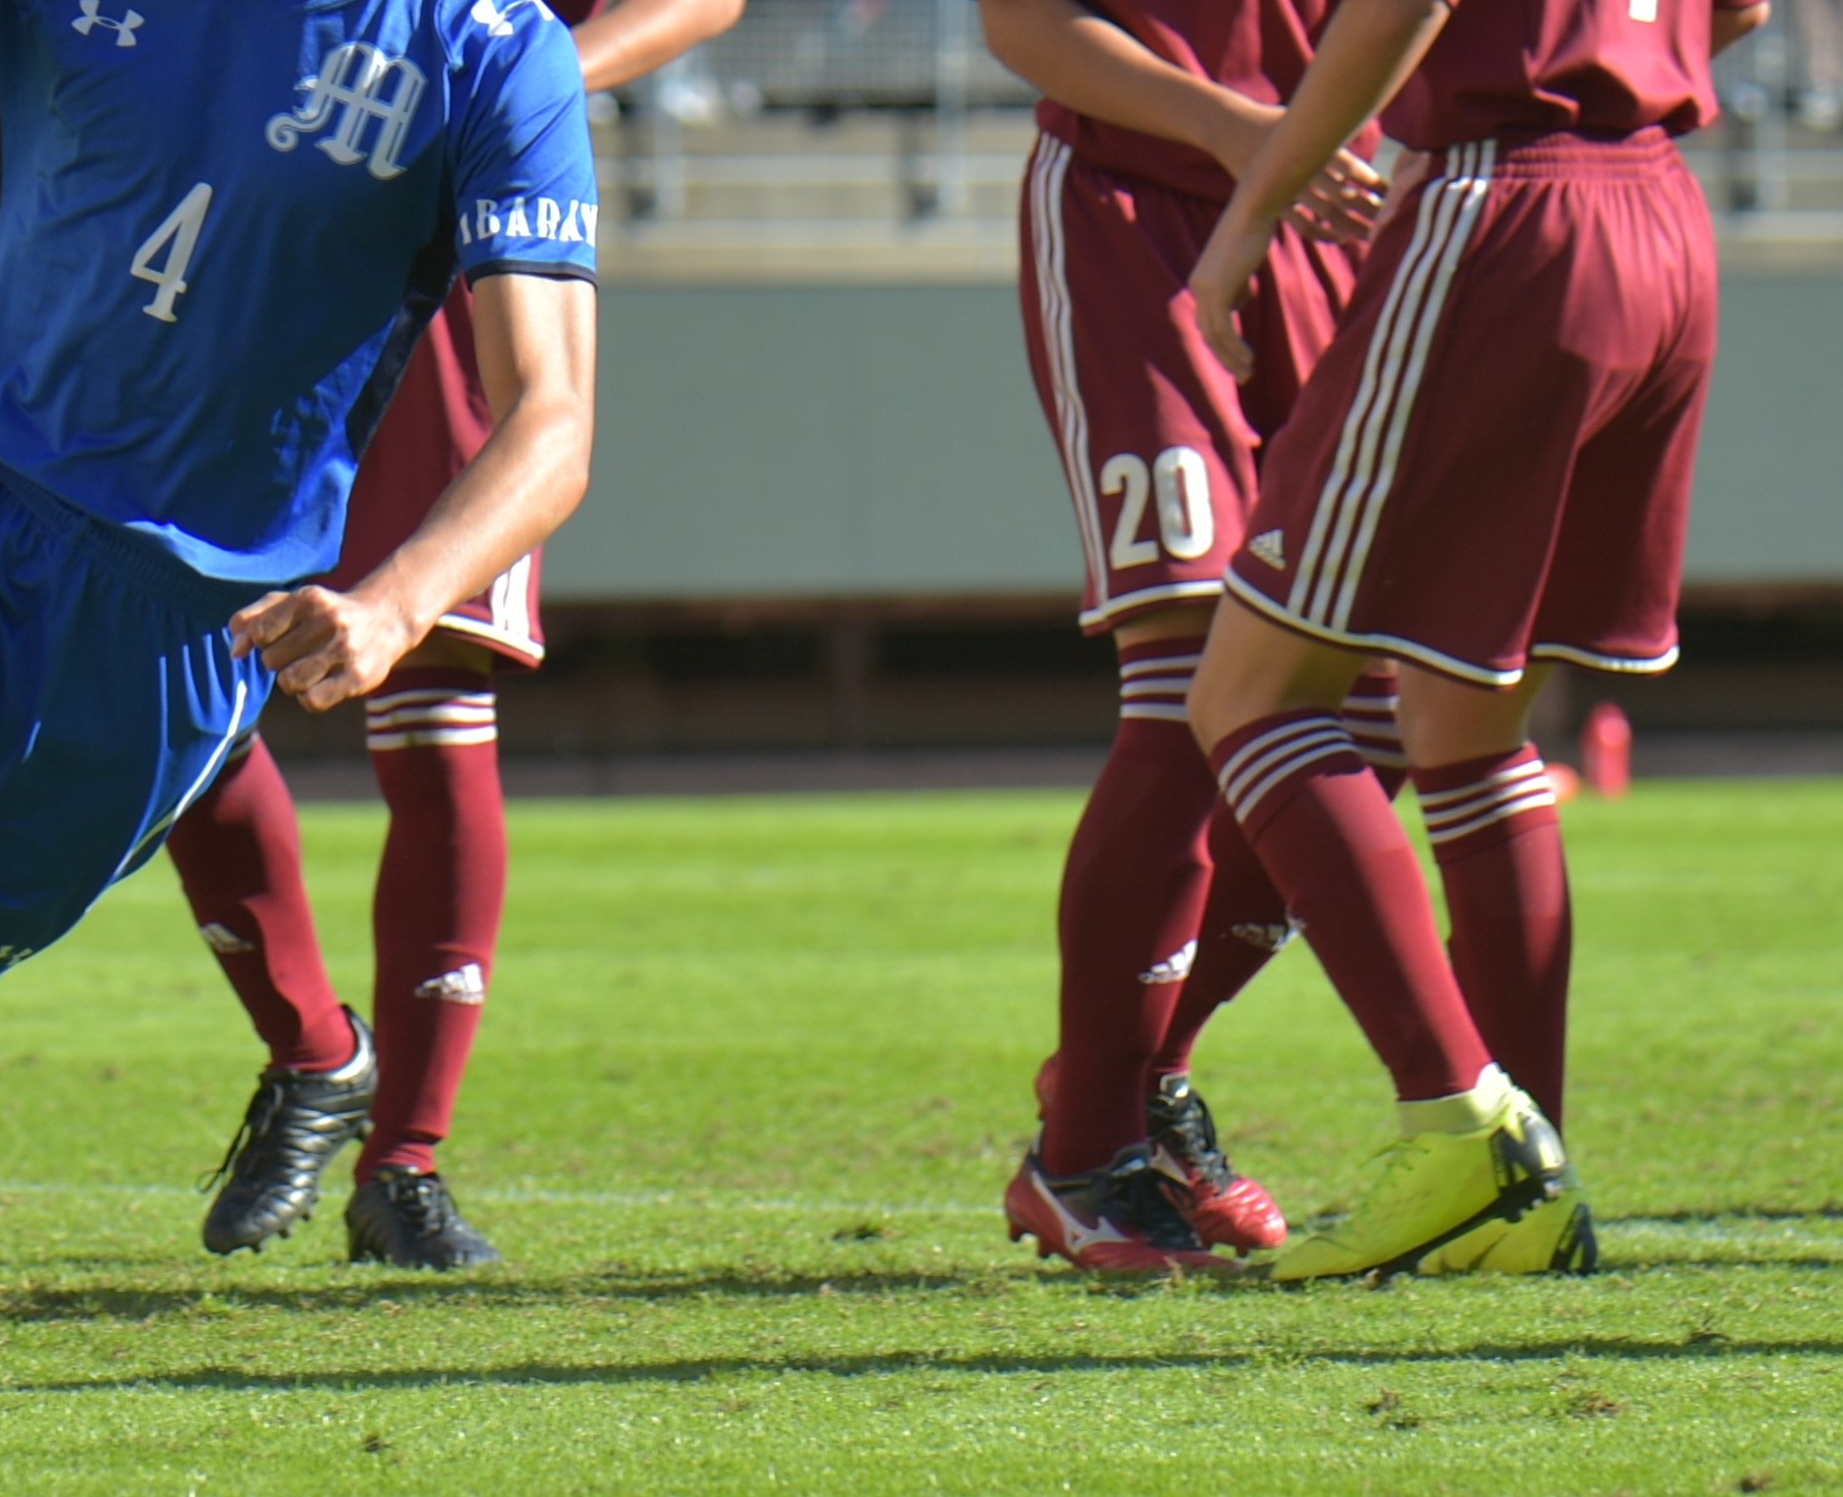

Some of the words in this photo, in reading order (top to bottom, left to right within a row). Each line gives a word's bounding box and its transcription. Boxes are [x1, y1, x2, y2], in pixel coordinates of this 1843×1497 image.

[266, 41, 429, 180] M
[131, 182, 213, 323] 4
[1100, 446, 1214, 570] 20
